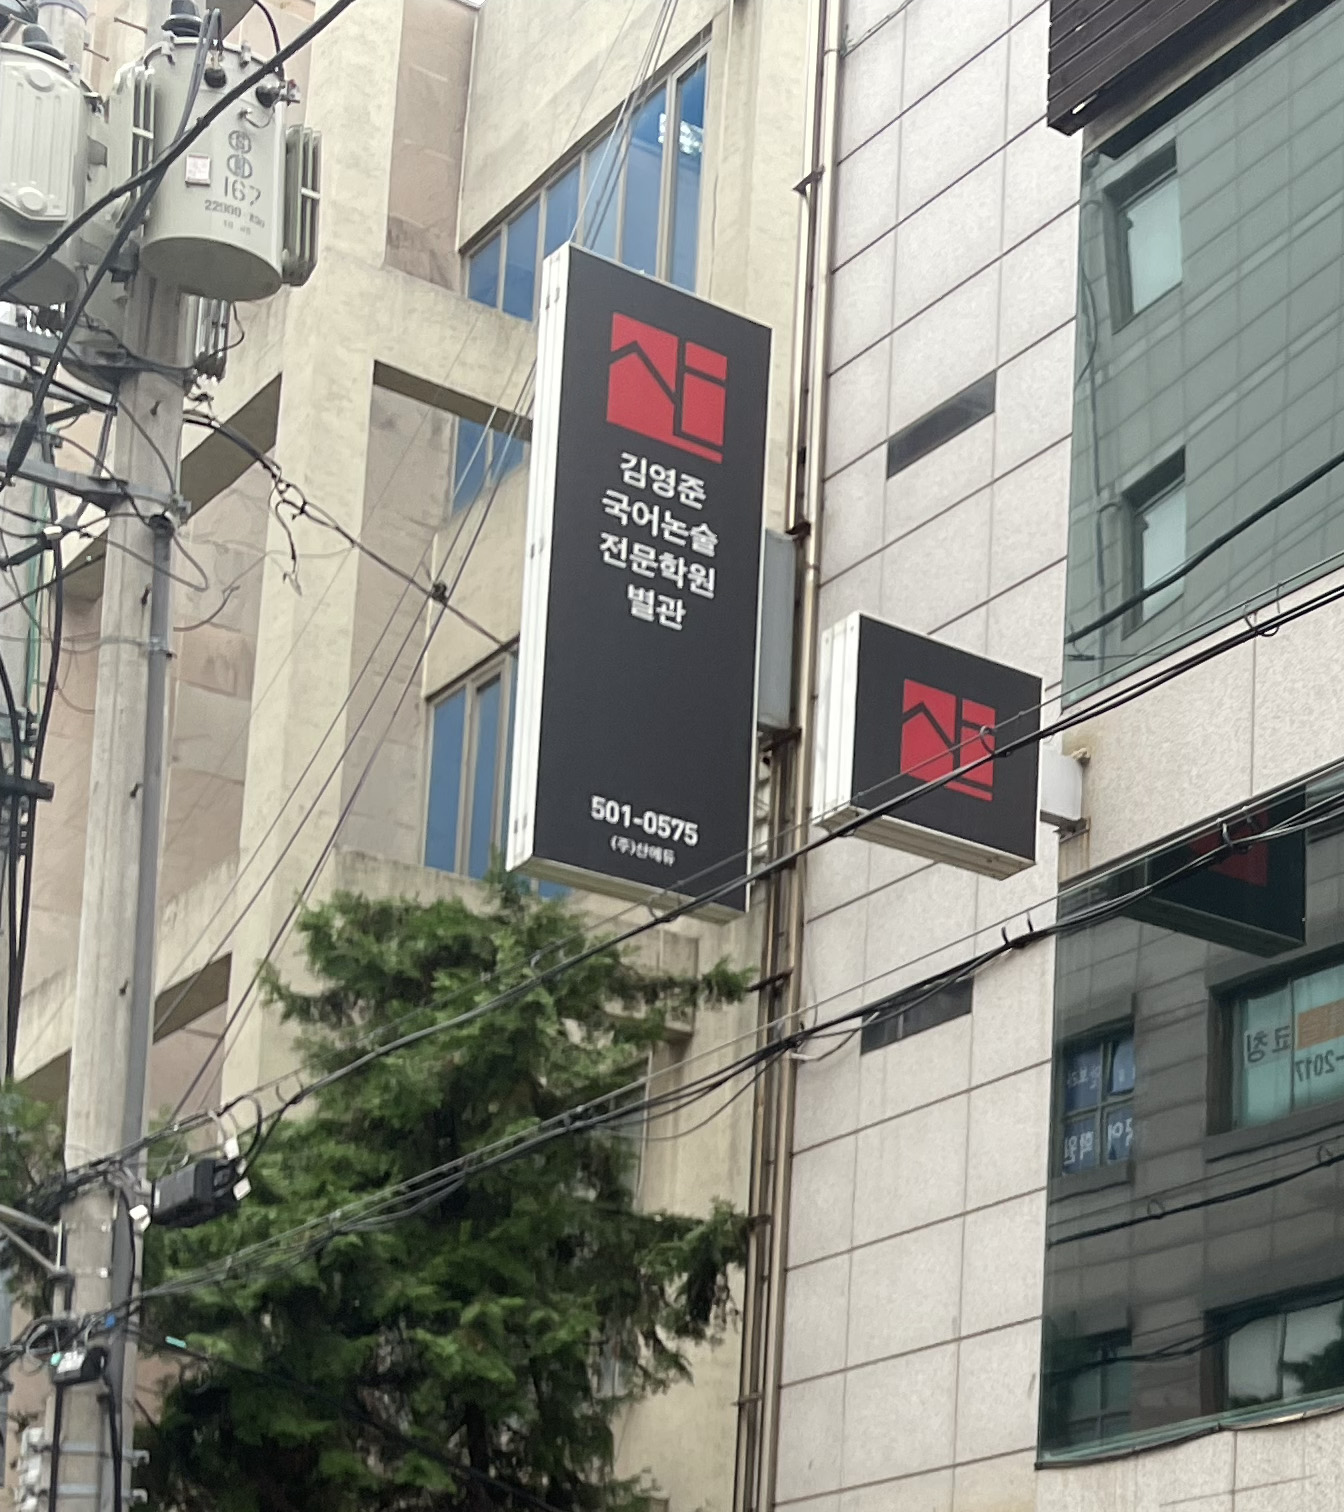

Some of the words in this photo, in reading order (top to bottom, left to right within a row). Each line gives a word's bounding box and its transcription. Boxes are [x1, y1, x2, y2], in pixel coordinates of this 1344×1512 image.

[620, 452, 706, 510] 김영준
[602, 489, 718, 557] 국어논술
[600, 532, 716, 599] 전문학원
[627, 584, 686, 630] 별관
[591, 795, 698, 847] 501-0575
